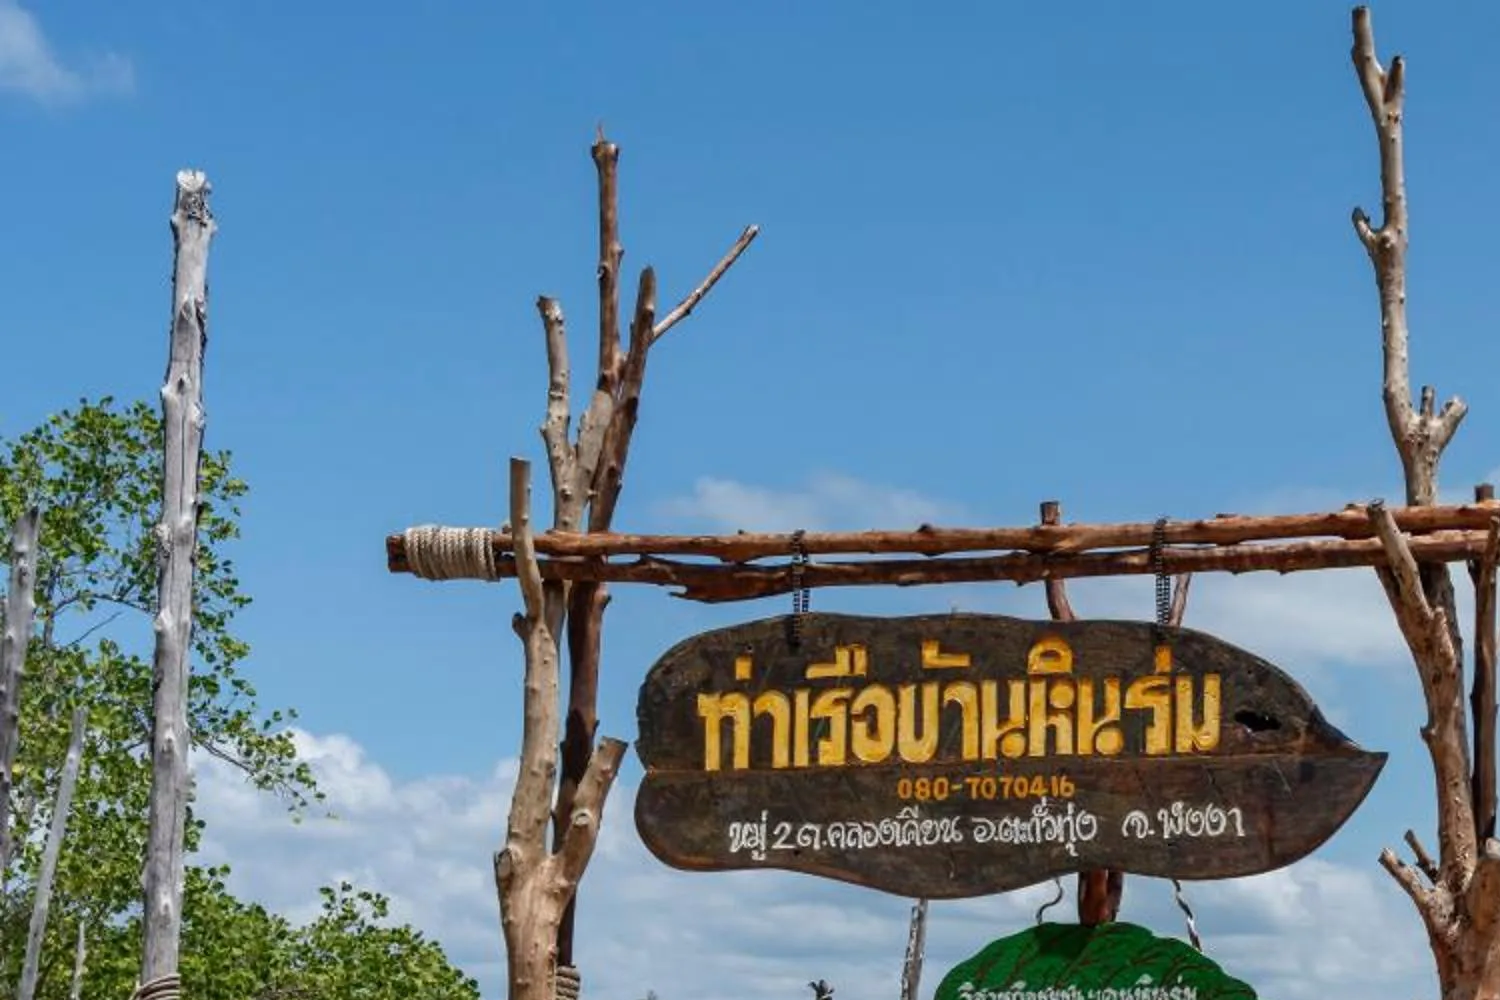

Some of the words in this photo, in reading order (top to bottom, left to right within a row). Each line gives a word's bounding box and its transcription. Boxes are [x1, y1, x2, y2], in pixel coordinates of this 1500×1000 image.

[697, 636, 1221, 771] ท่าเรือบ้านหินร่ม
[897, 775, 1076, 800] 080-7070416
[1121, 800, 1246, 839] จ.พังงา
